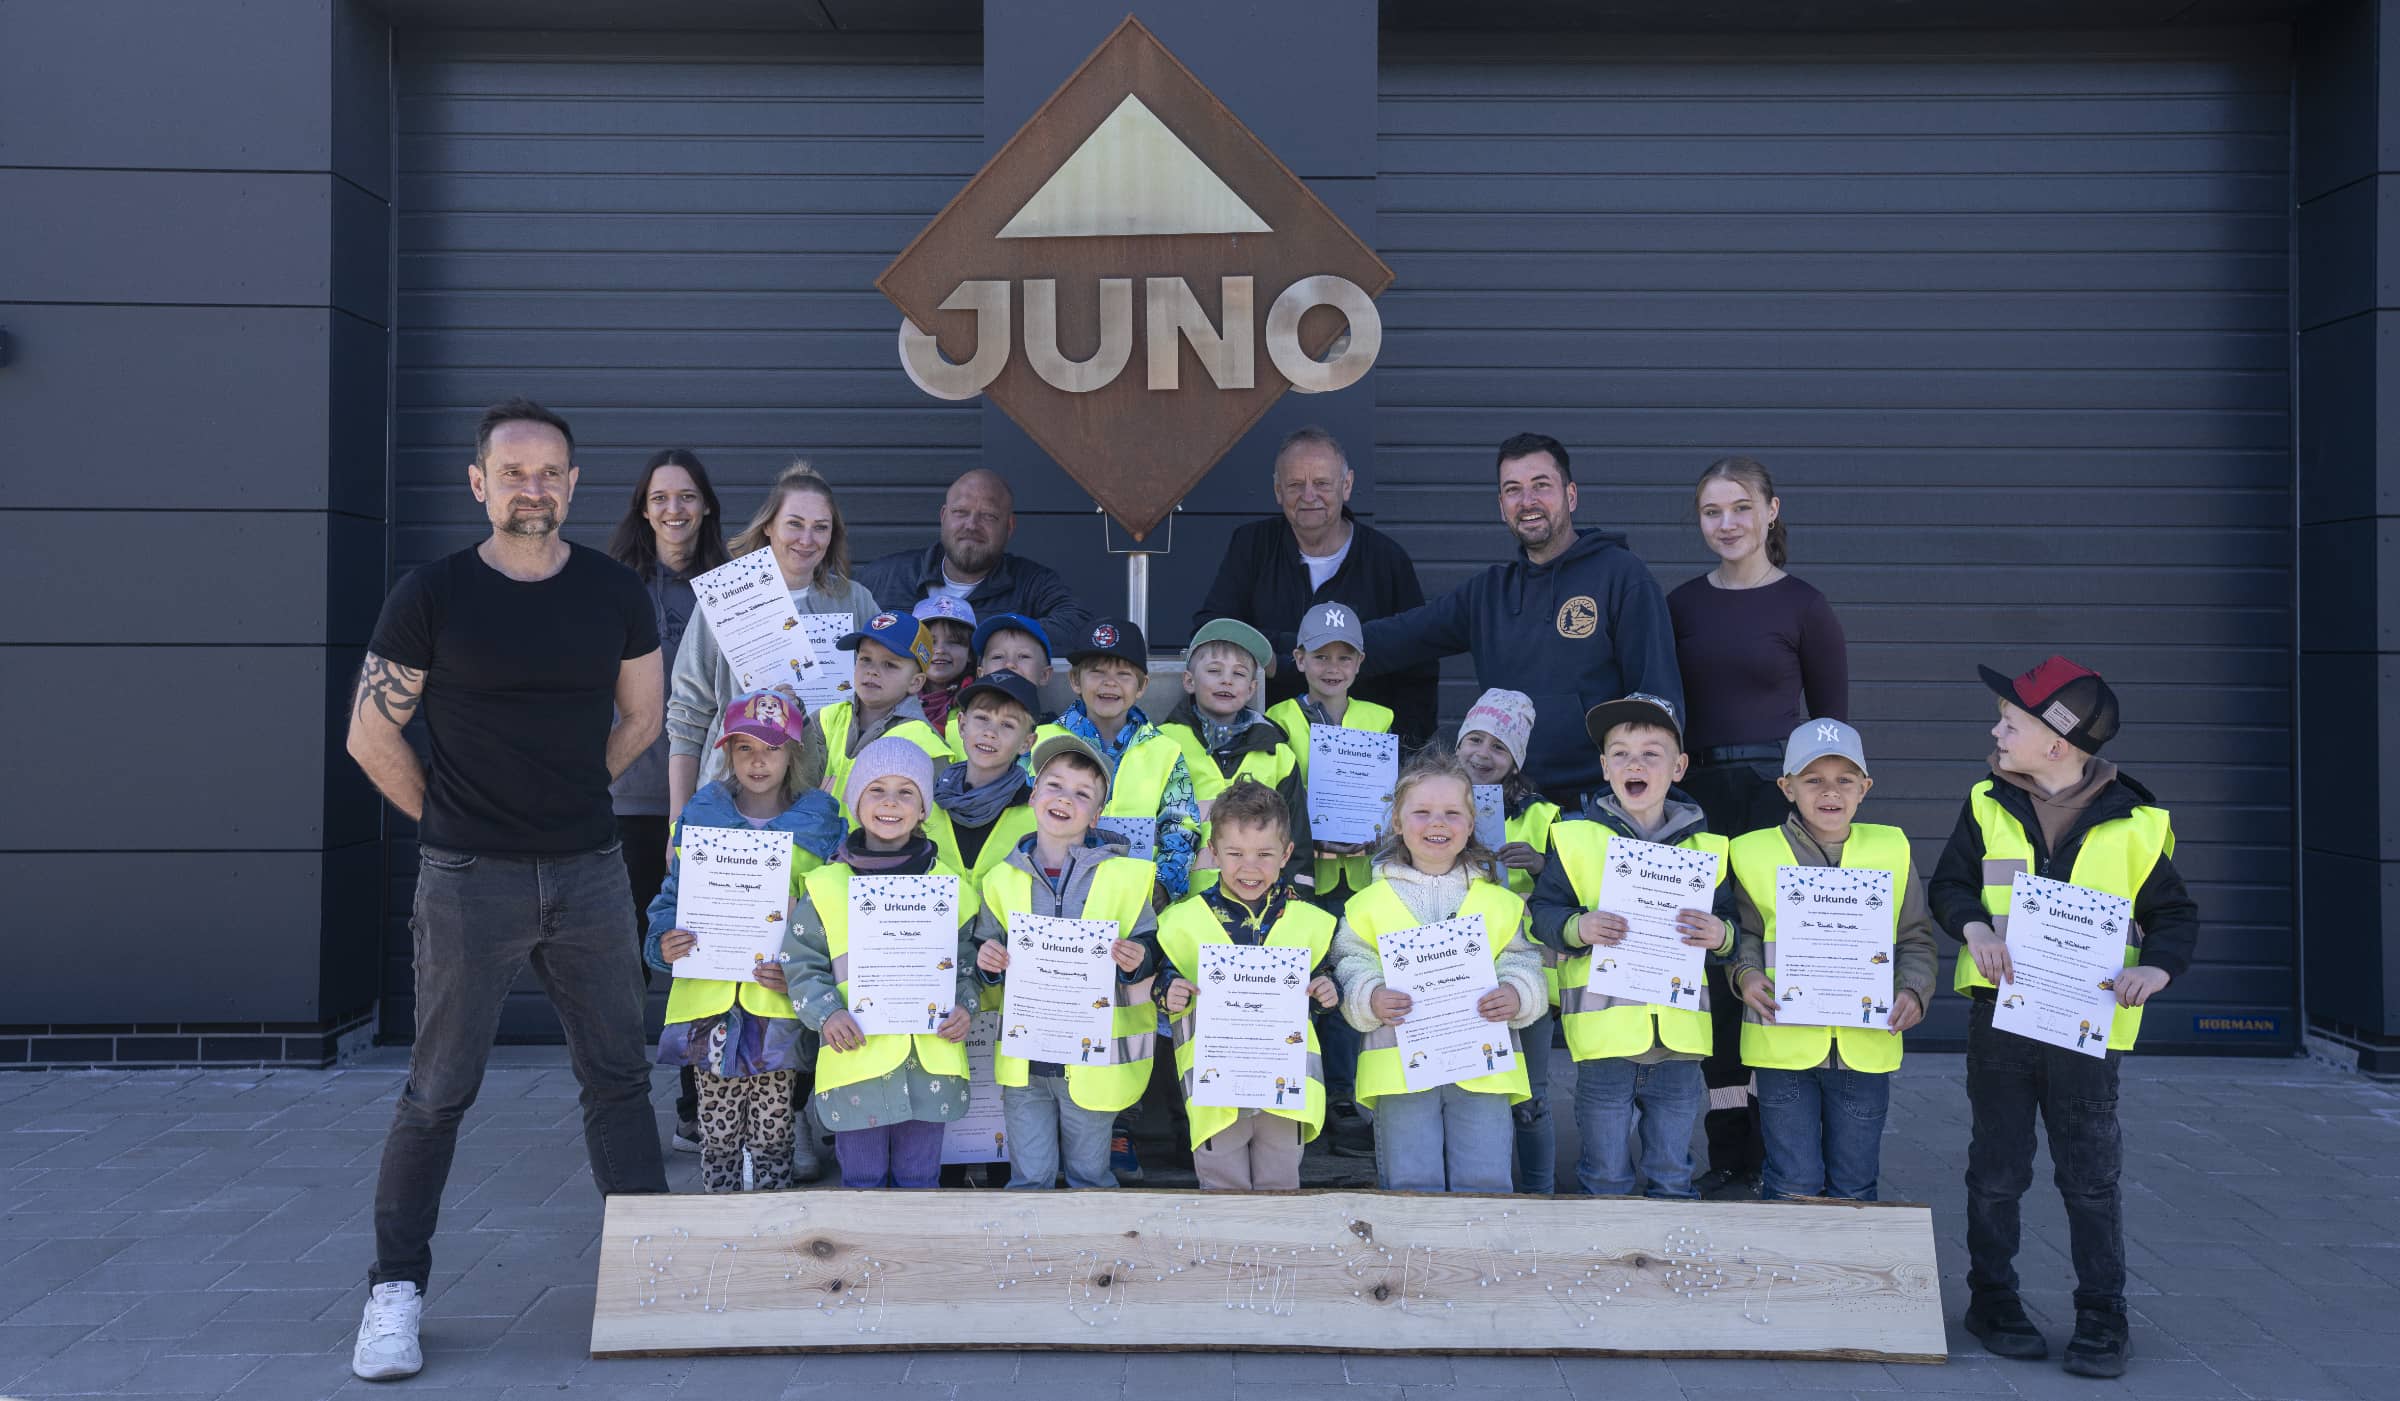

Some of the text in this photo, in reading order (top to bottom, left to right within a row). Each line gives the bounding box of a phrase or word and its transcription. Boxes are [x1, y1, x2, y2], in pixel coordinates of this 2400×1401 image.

[898, 274, 1382, 400] JUNO
[721, 582, 755, 600] Urkunde
[1325, 609, 1345, 628] NY
[1817, 724, 1840, 742] NY
[1337, 747, 1373, 759] Urkunde
[715, 854, 758, 866] Urkunde
[1639, 868, 1682, 884] Urkunde
[884, 902, 927, 912] Urkunde
[1813, 894, 1858, 905] Urkunde
[2049, 907, 2094, 926] Urkunde
[1041, 942, 1084, 954] Urkunde
[1416, 948, 1458, 964] Urkunde
[1233, 973, 1277, 983] Urkunde
